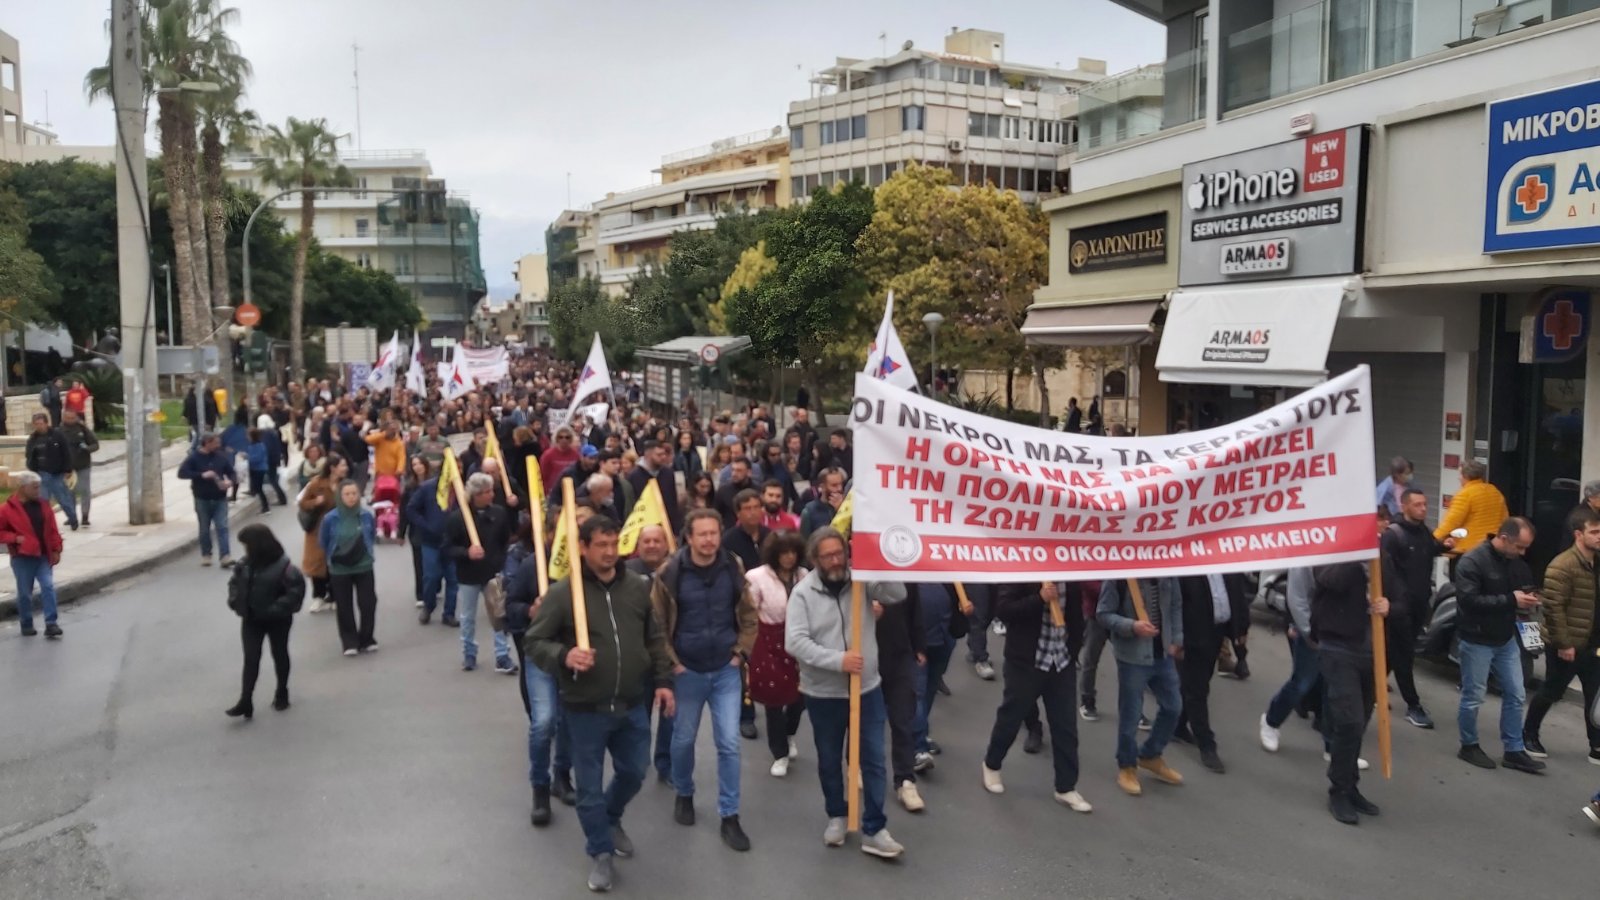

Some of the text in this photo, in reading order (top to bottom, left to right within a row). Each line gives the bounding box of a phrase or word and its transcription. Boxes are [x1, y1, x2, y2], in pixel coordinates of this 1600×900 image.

[1311, 138, 1339, 155] NEW
[1320, 155, 1328, 167] &
[1207, 168, 1296, 207] iPhone
[1308, 168, 1339, 184] USED
[1193, 203, 1339, 237] SERVICE & ACCESSORIES
[1088, 228, 1164, 257] ΧΑΡΩΝΙΤΗΣ
[1225, 242, 1284, 264] ARMAOS
[1209, 329, 1270, 347] ARMAOS
[854, 397, 884, 424] ΟΙ
[898, 403, 1014, 454] ΝΕΚΡΟΙ
[1024, 441, 1103, 469] ΜΑΣ,
[1111, 448, 1154, 466] ΤΑ
[1293, 388, 1361, 423] ΤΟΥΣ
[905, 437, 931, 462] Η
[943, 442, 1032, 476] ΟΡΓΗ
[1039, 466, 1111, 489] ΜΑΣ
[1120, 464, 1173, 483] ΝΑ
[876, 452, 1337, 511] ΤΗΝ ΠΟΛΙΤΙΚΗ ΠΟΥ ΜΕΤΡΑΕΙ
[910, 487, 1306, 534] ΤΗ ΖΩΗ ΜΑΣ ΩΣ ΚΟΣΤΟΣ
[928, 543, 1048, 562] ΣΥΝΔΙΚΑΤΟ
[1054, 542, 1184, 562] ΟΙΚΟΔΟΜΩΝ
[1191, 540, 1213, 557] Ν.
[1218, 526, 1338, 553] ΗΡΑΚΛΕΙΟΥ
